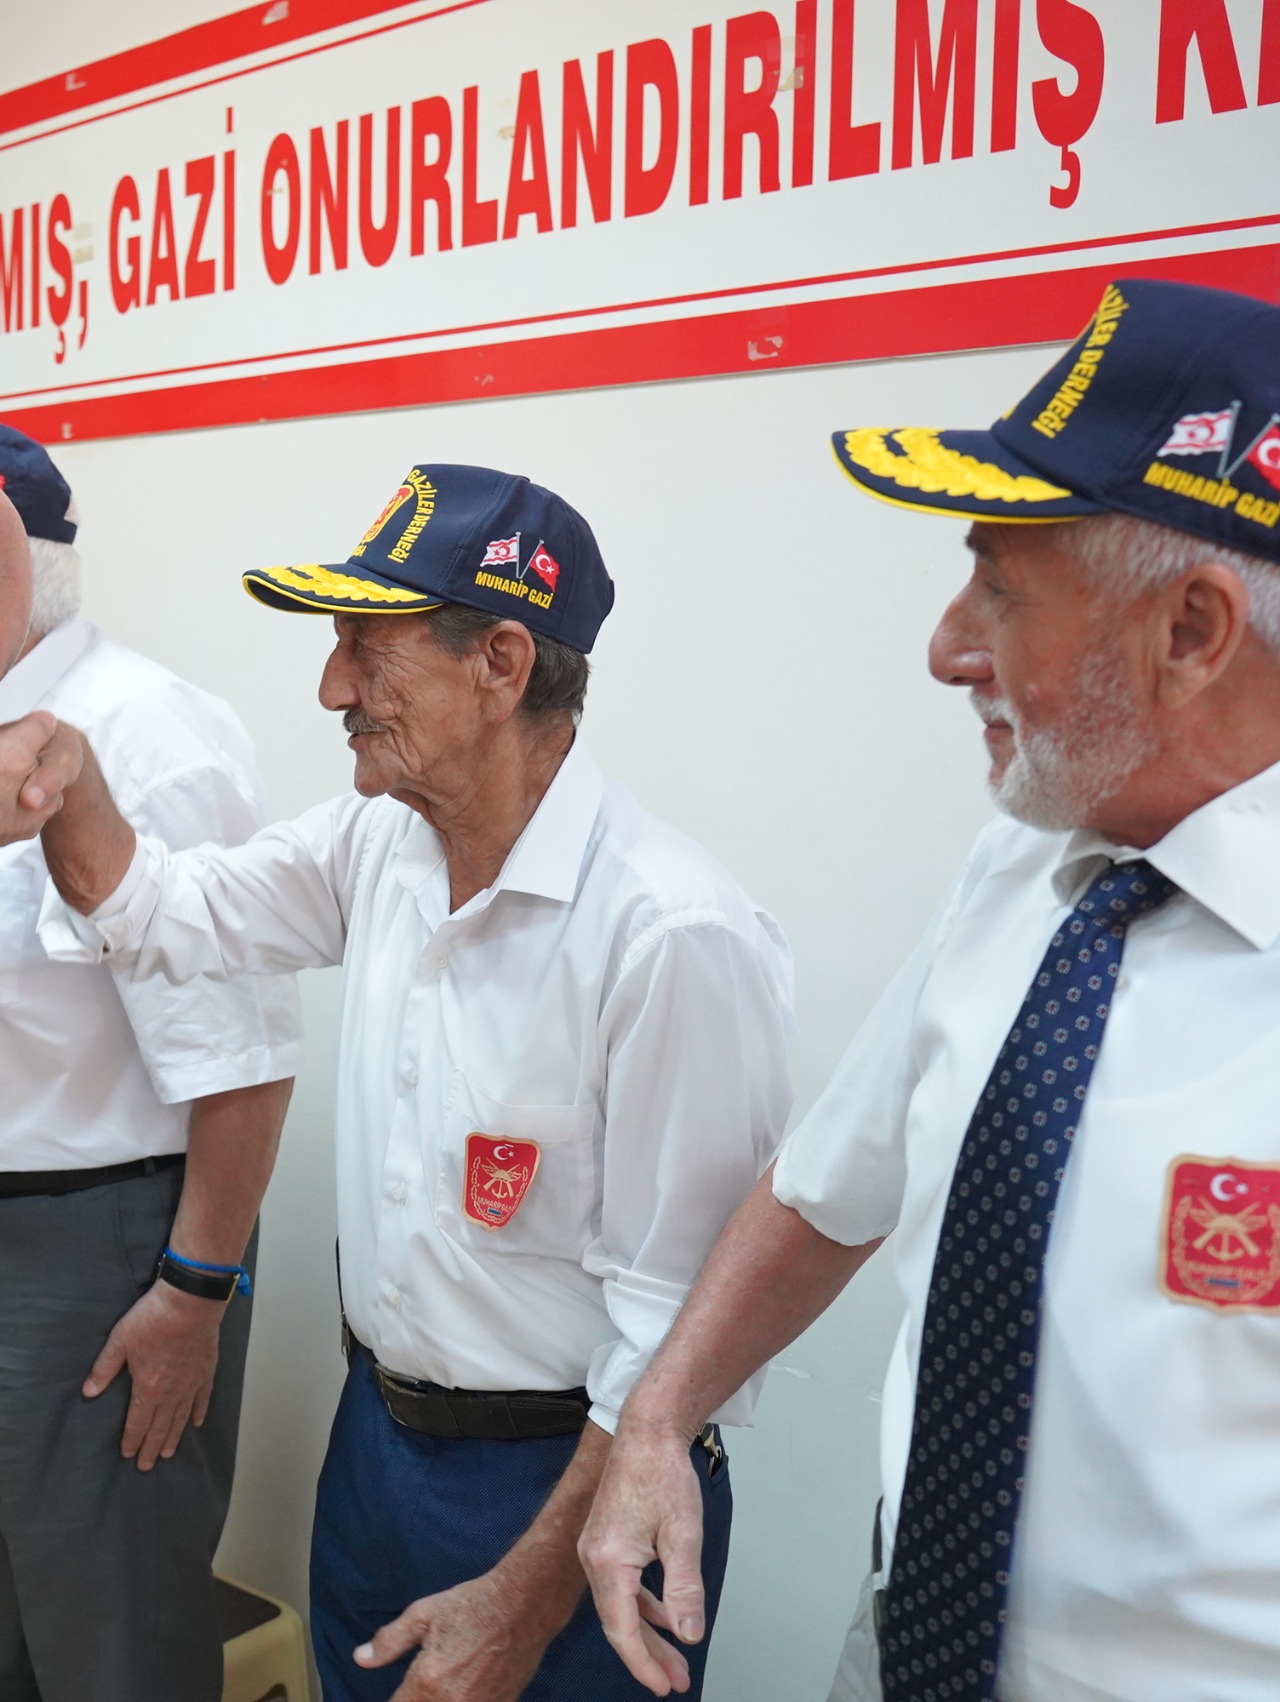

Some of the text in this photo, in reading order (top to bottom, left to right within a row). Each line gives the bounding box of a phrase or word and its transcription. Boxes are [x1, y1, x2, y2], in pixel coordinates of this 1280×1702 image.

[108, 106, 236, 314] GAZİ
[261, 0, 1105, 286] ONURLANDIRILMIŞ
[475, 571, 554, 610] MUHARİP GAZİ
